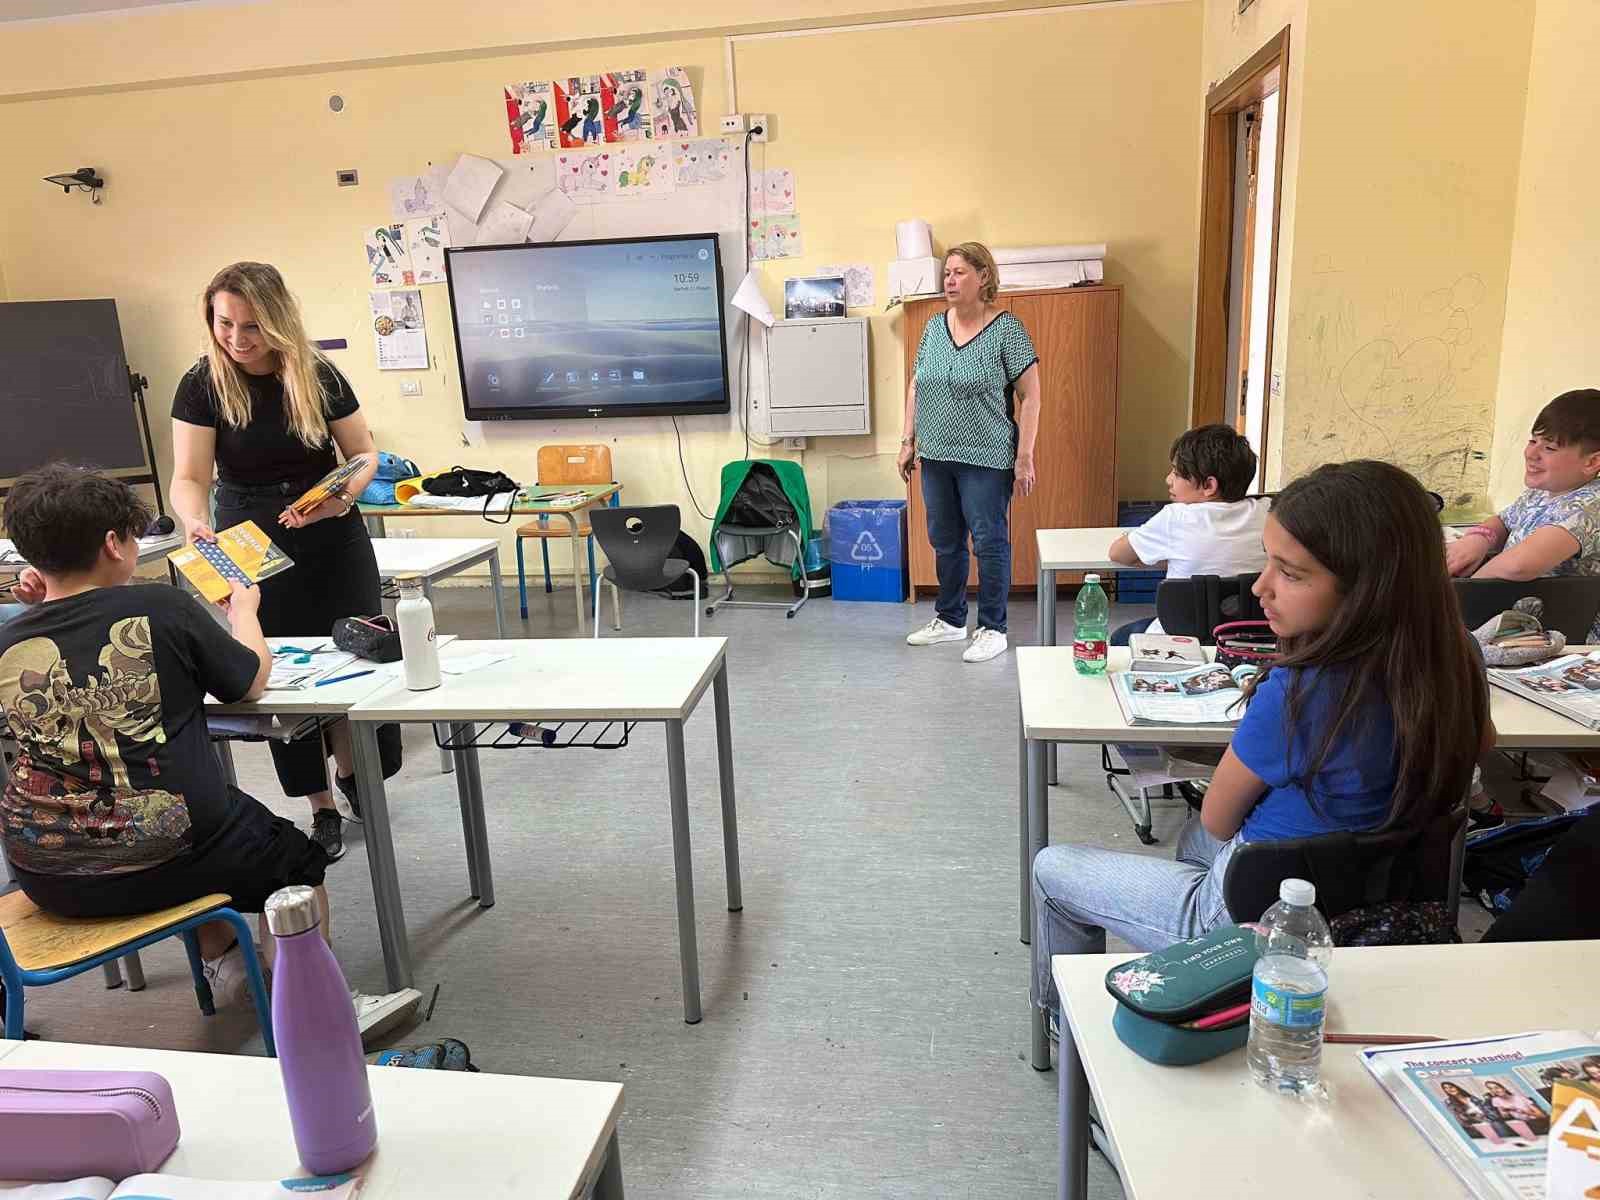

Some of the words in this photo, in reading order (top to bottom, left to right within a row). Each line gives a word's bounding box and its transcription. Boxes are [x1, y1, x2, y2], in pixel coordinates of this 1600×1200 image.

[673, 272, 700, 283] 10:59
[1182, 953, 1202, 964] FIND
[1202, 944, 1223, 955] YOUR
[1224, 937, 1243, 946] OWN
[1405, 1061, 1425, 1069] The
[1427, 1058, 1476, 1066] concert's
[1478, 1051, 1523, 1063] starting!
